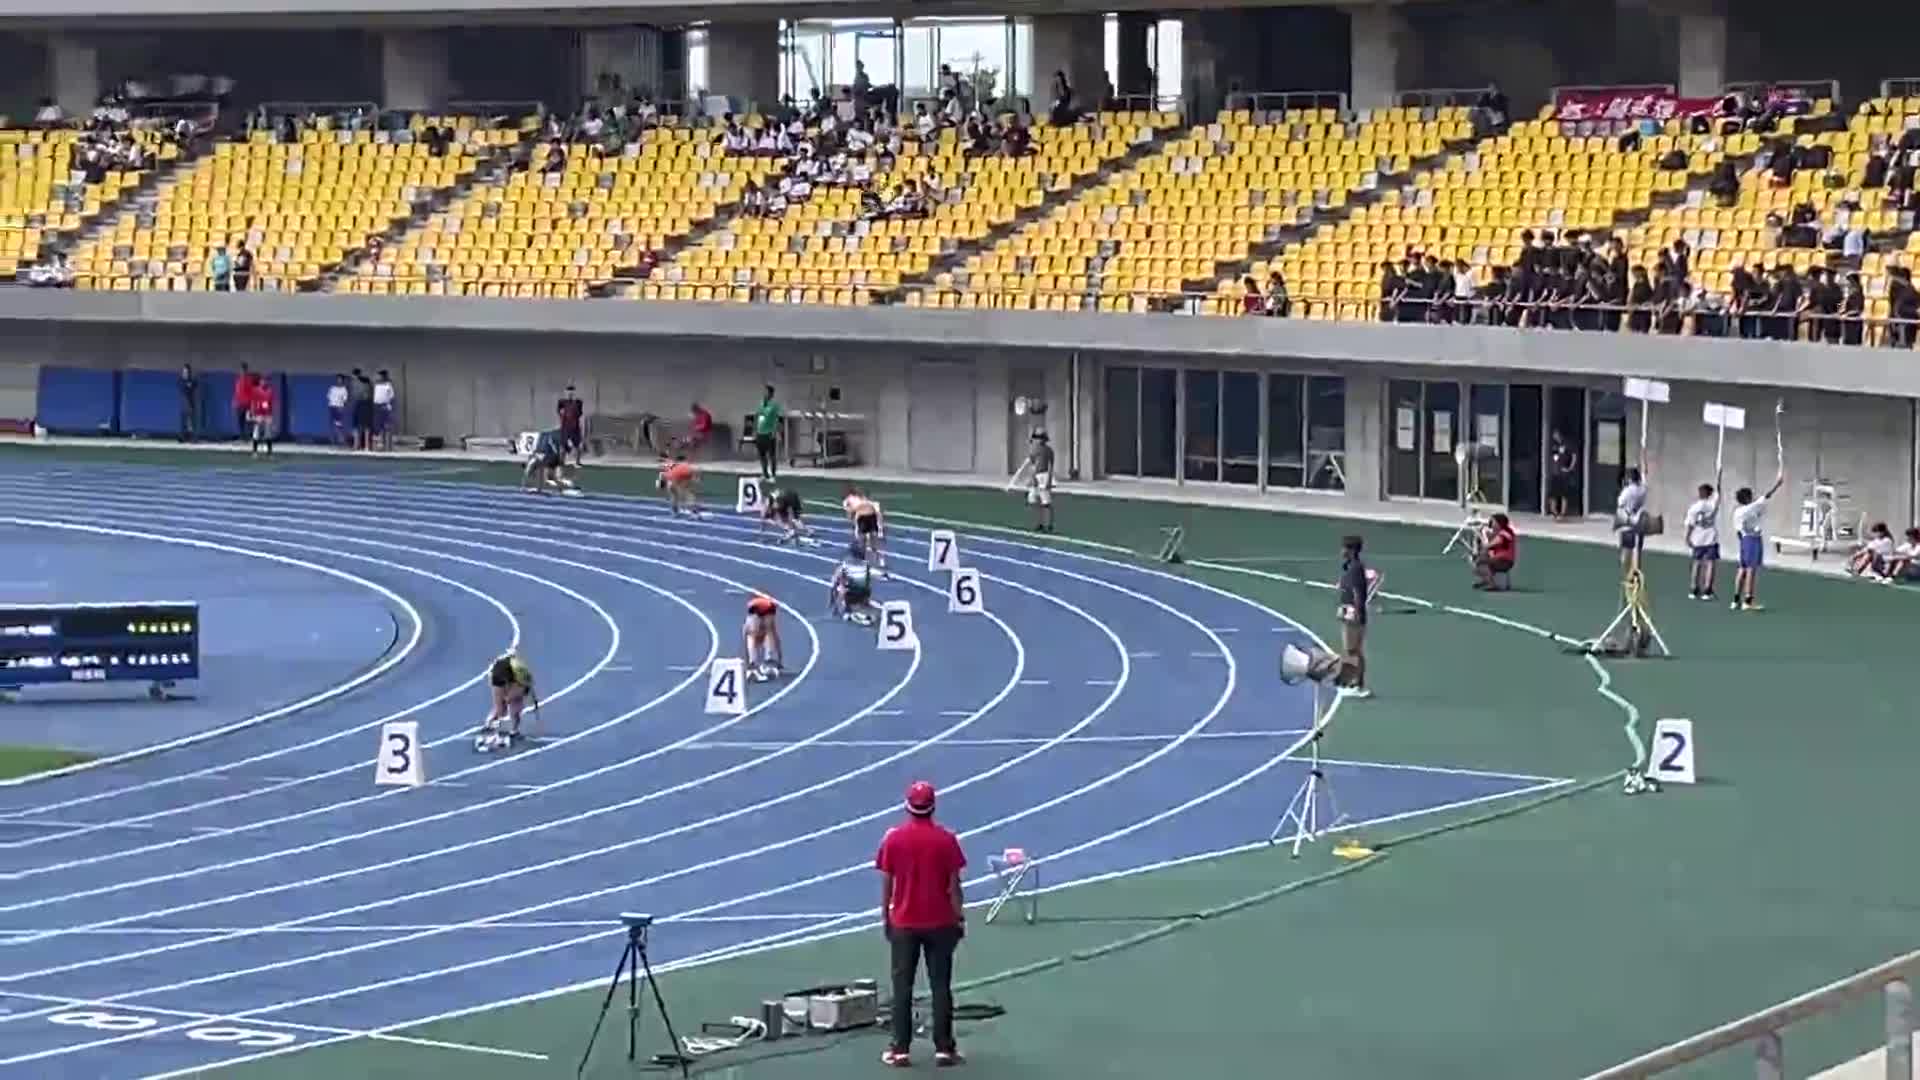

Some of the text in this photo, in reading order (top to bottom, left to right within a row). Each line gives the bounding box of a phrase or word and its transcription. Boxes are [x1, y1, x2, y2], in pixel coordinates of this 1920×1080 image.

[743, 483, 758, 507] 9
[934, 537, 952, 565] 7
[956, 576, 977, 606] 6
[887, 609, 906, 642] 5
[713, 670, 738, 704] 4
[387, 733, 410, 774] 3
[1659, 732, 1685, 772] 2
[49, 1012, 158, 1030] 8
